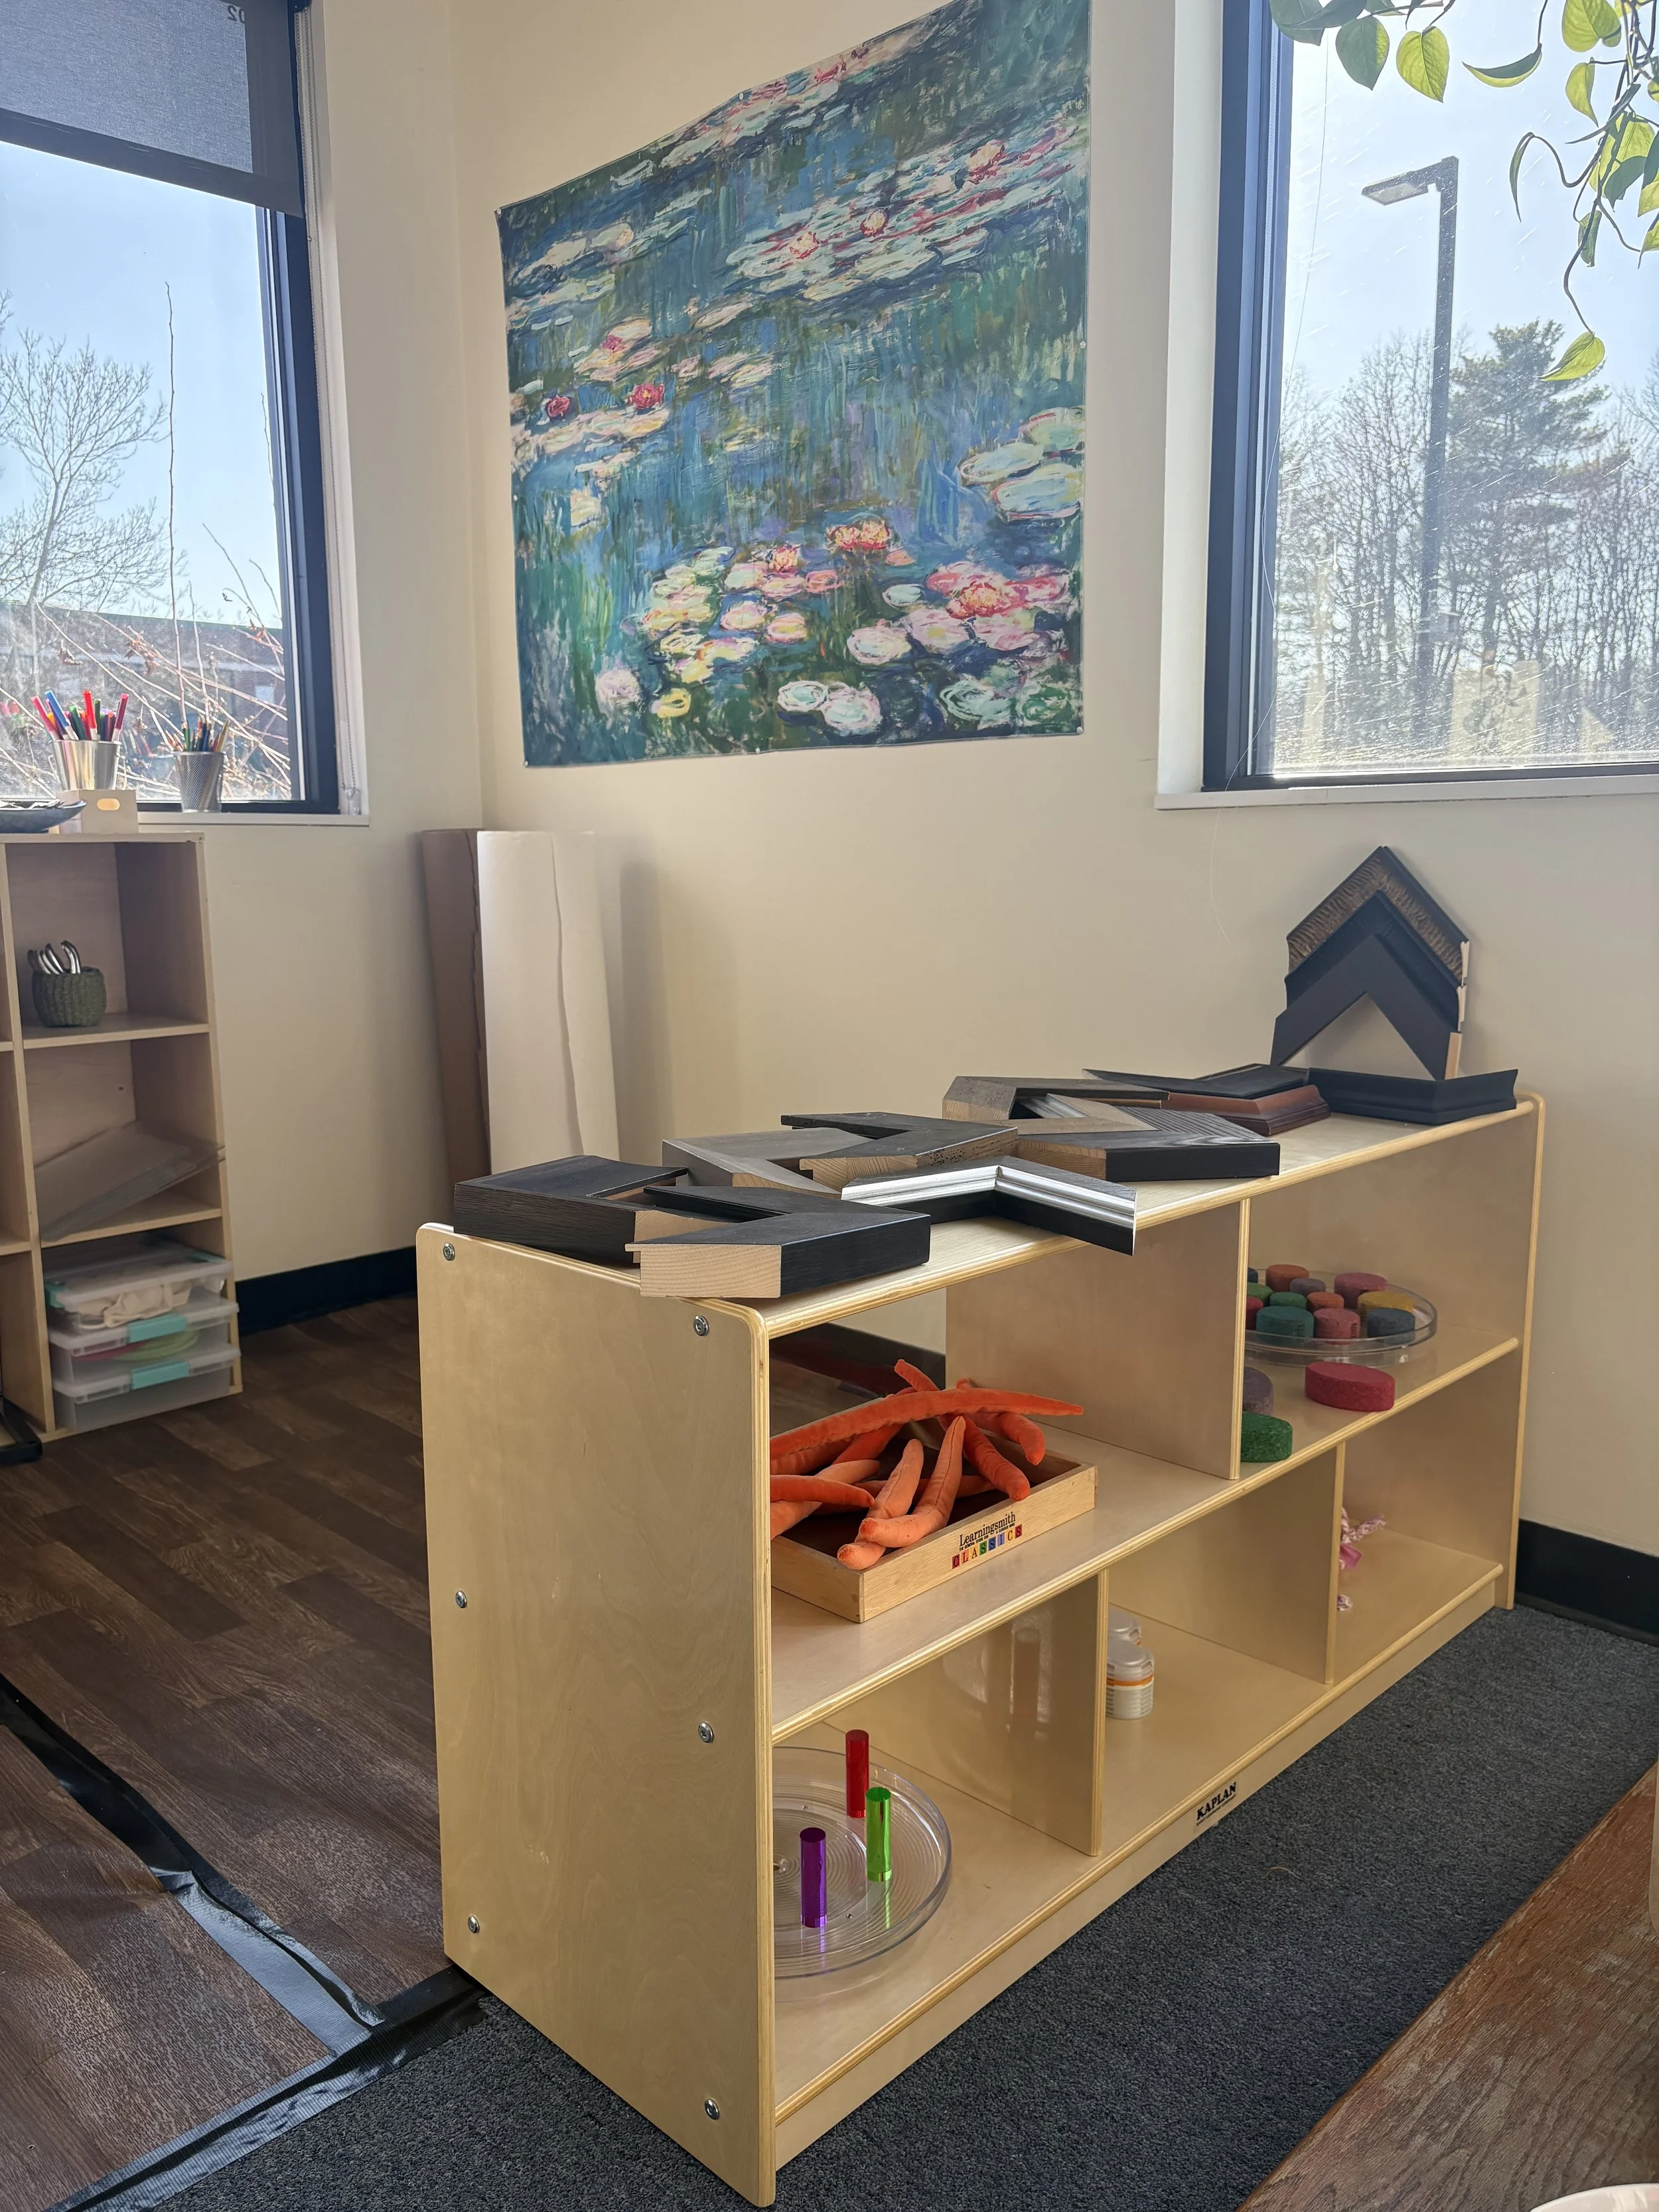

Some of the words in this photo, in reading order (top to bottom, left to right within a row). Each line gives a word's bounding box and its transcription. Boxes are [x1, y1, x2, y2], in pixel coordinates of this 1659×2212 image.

[953, 1526, 1021, 1568] CLASSICS
[960, 1512, 1016, 1546] Learningsmith
[1196, 1782, 1236, 1820] KAPLAN
